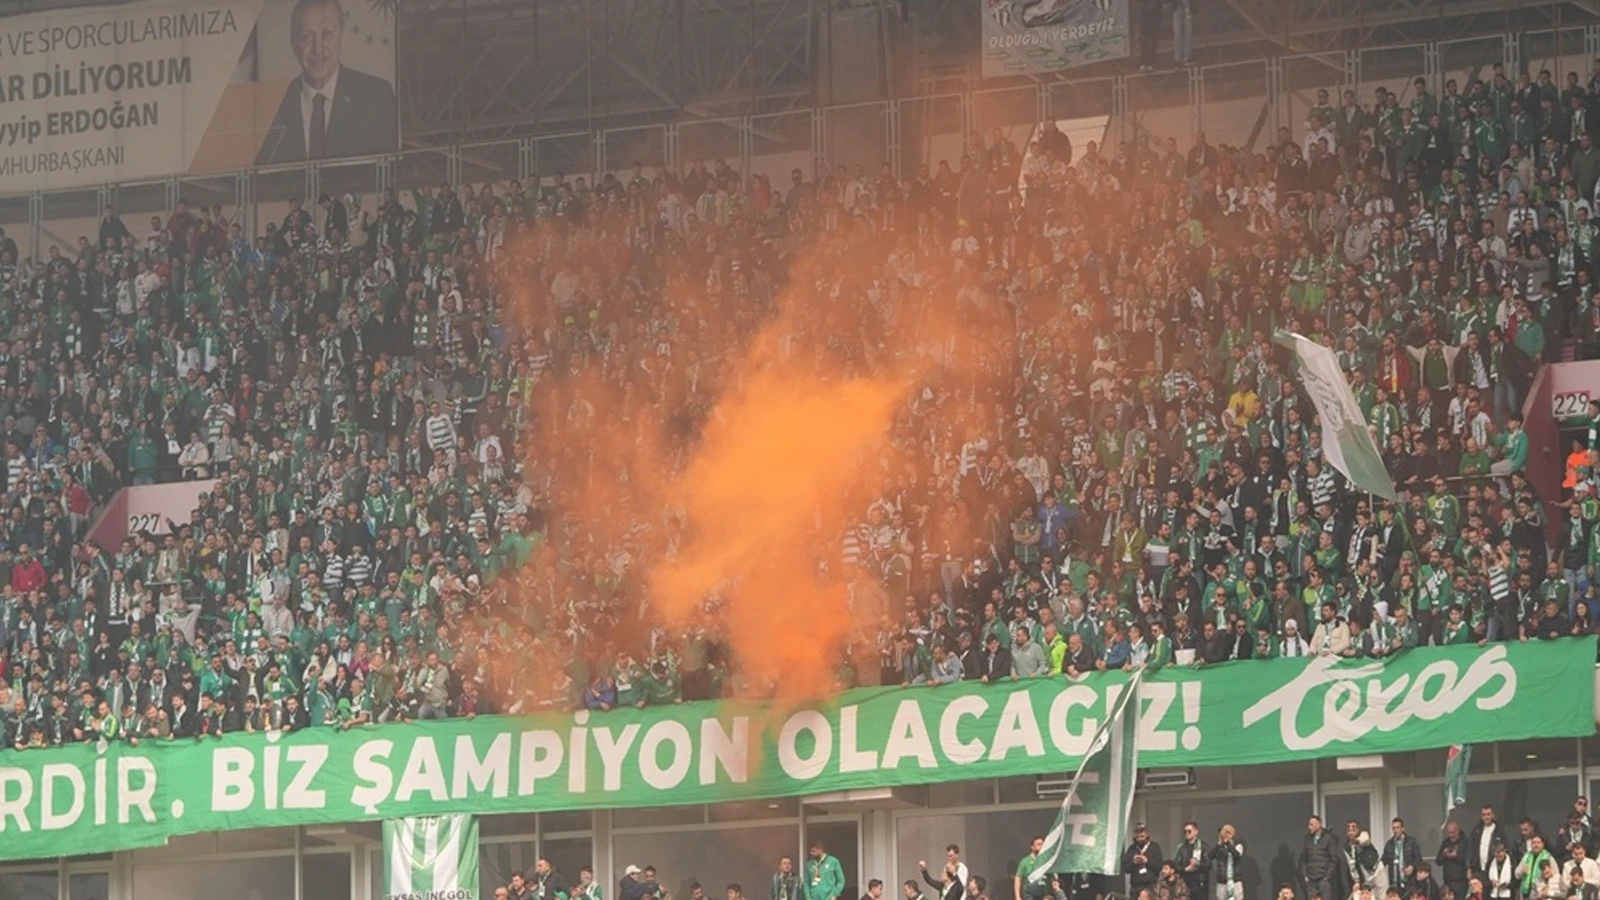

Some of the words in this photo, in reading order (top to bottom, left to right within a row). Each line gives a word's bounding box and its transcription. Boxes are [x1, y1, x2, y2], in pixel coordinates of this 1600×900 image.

[7, 31, 34, 56] VE
[38, 9, 237, 52] SPORCULARIMIZA
[32, 56, 192, 100] DİLİYORUM
[47, 100, 158, 135] ERDOĞAN
[1553, 392, 1589, 415] 229
[129, 514, 160, 533] 227
[211, 730, 329, 812] BİZ
[351, 709, 750, 814] ŞAMPİYON
